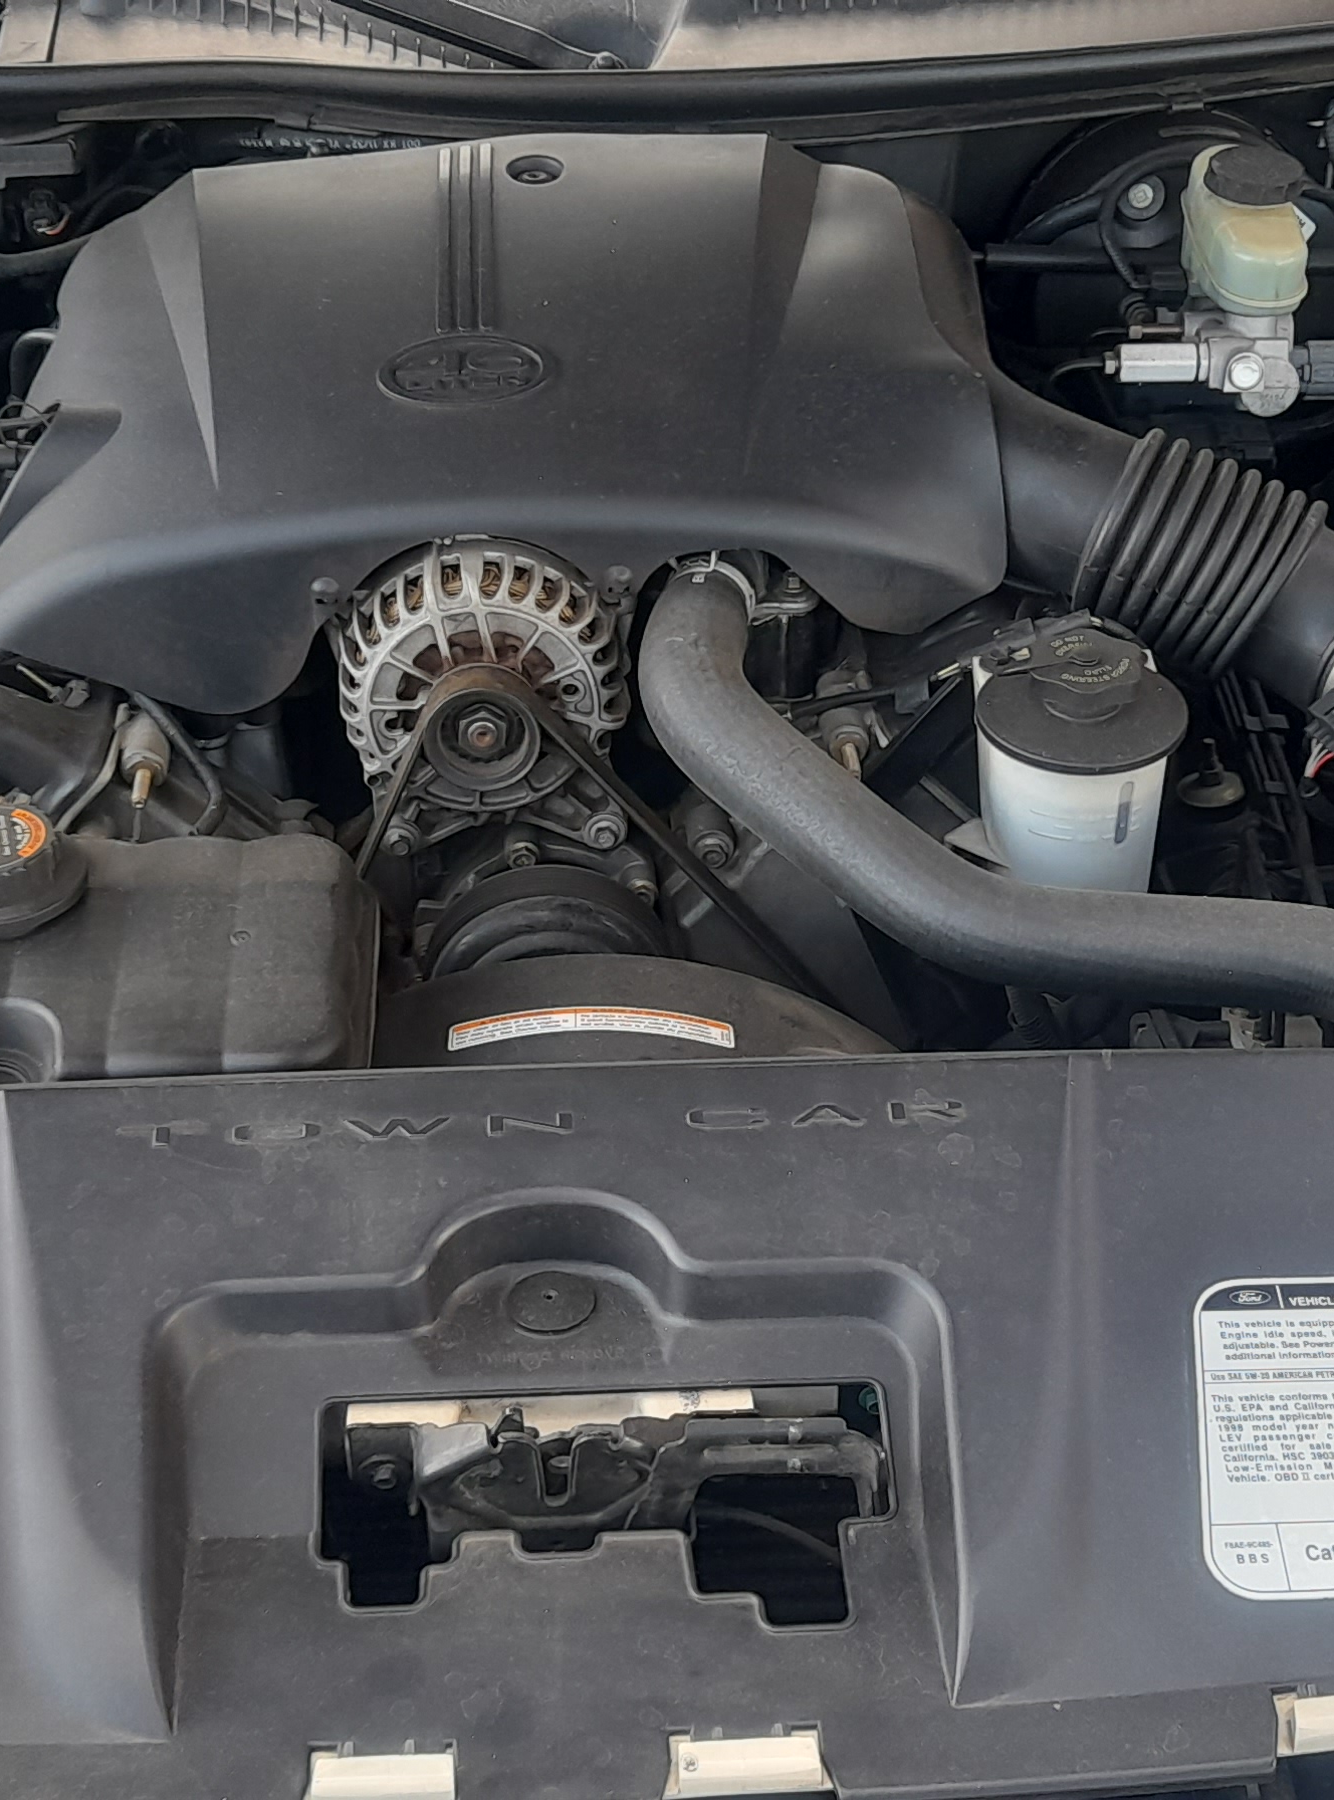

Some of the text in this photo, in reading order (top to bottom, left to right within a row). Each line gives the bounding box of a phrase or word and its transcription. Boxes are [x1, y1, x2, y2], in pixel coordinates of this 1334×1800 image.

[115, 1096, 966, 1149] TOWN CAR
[1238, 1291, 1263, 1304] Ford
[1218, 1320, 1240, 1329] This
[1245, 1320, 1282, 1328] vehicle
[1285, 1319, 1295, 1328] is
[1220, 1331, 1259, 1341] Engine
[1264, 1330, 1284, 1339] idle
[1223, 1342, 1280, 1352] adjustable.
[1225, 1352, 1276, 1361] additional
[1211, 1394, 1234, 1403] This
[1238, 1393, 1276, 1402] vehicle
[1279, 1392, 1328, 1401] conforms
[1213, 1404, 1236, 1413] U.S.
[1241, 1403, 1264, 1412] EPA
[1269, 1403, 1289, 1411] and
[1215, 1413, 1275, 1424] regulations
[1279, 1412, 1333, 1422] applicable
[1252, 1423, 1287, 1432] model
[1295, 1423, 1319, 1433] year
[1219, 1434, 1242, 1443] LEV
[1253, 1433, 1316, 1443] passenger
[1221, 1443, 1268, 1453] certified
[1280, 1443, 1296, 1451] for
[1309, 1442, 1332, 1450] sale
[1282, 1452, 1306, 1461] HSC
[1225, 1463, 1313, 1473] Low-Emission
[1274, 1472, 1299, 1482] OBD
